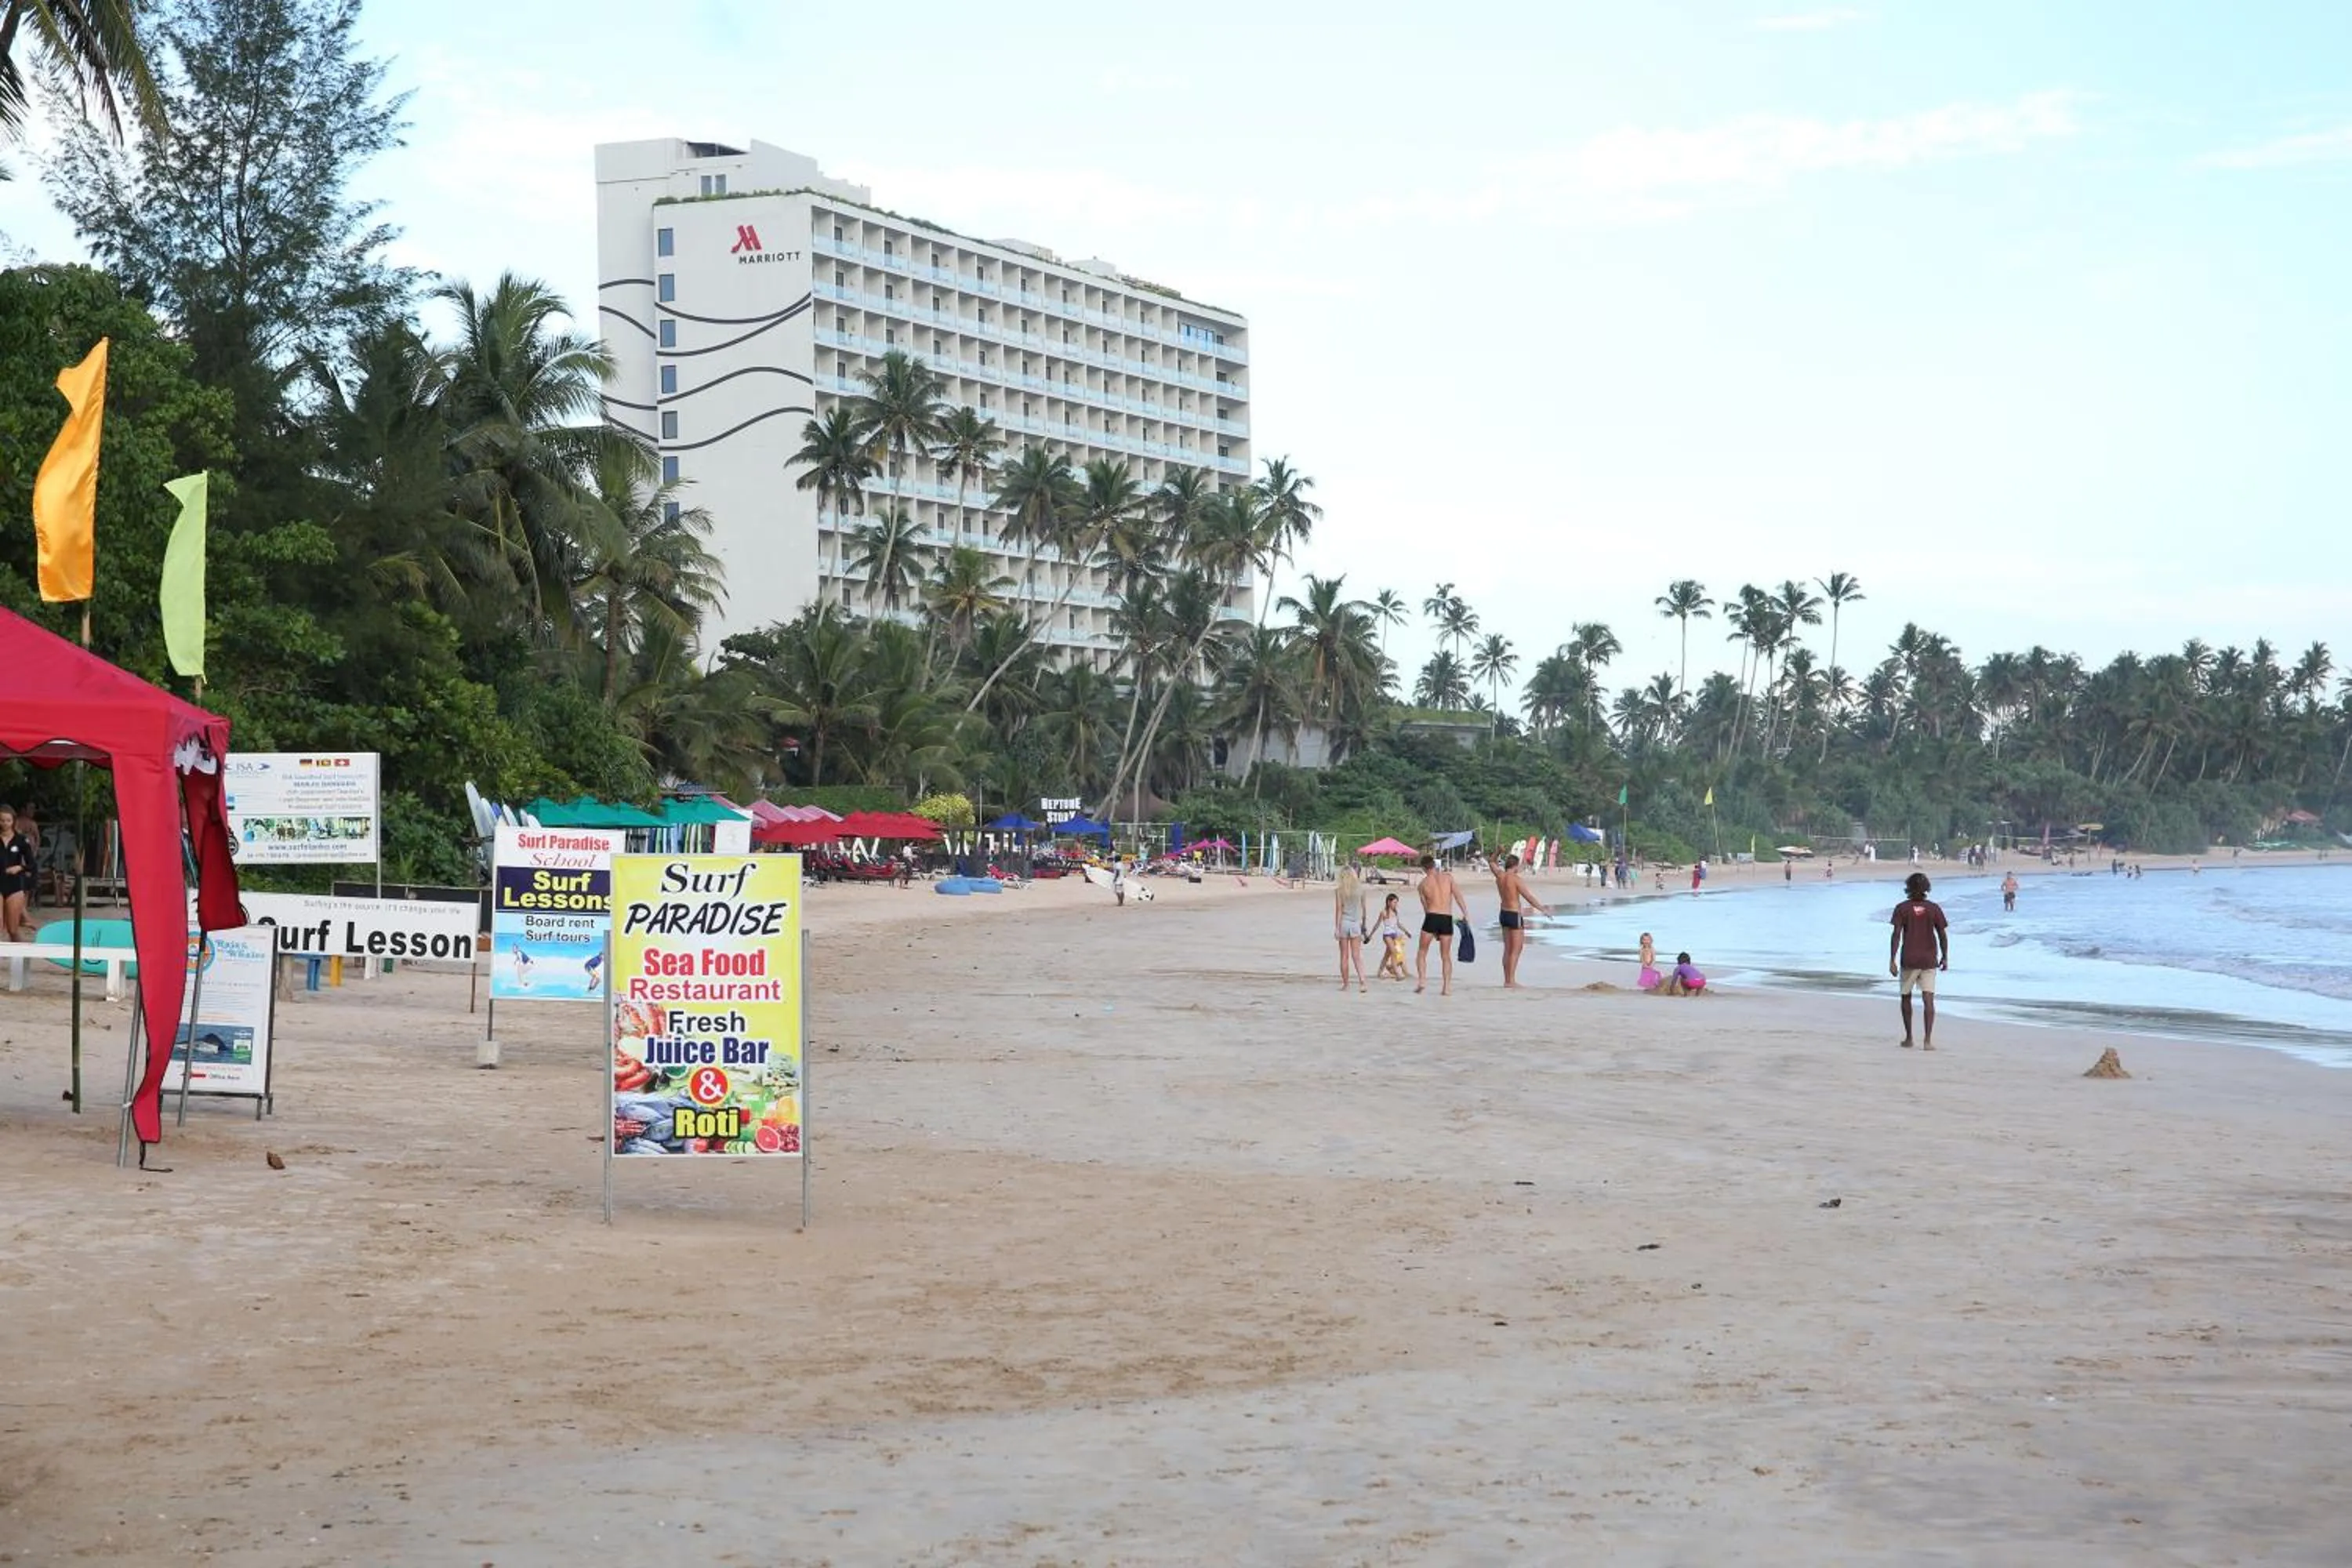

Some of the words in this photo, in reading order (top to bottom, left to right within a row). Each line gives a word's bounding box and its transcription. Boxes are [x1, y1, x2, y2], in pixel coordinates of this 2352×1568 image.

[739, 252, 800, 264] MARRIOTT
[518, 833, 546, 848] Surf
[550, 835, 610, 851] Paradise
[529, 851, 597, 867] School
[533, 869, 592, 891] Surf
[661, 862, 757, 897] Surf
[525, 915, 564, 927] Board
[568, 916, 594, 928] rent
[624, 902, 787, 936] PARADISE
[346, 921, 472, 959] Lesson
[526, 930, 553, 942] Surf
[556, 931, 590, 943] tours
[644, 949, 695, 976] Sea
[702, 949, 765, 976] Food
[630, 978, 781, 1001] Restaurant
[668, 1011, 746, 1033] Fresh
[644, 1037, 716, 1064] Juice
[723, 1038, 769, 1064] Bar
[698, 1071, 724, 1100] &
[673, 1107, 741, 1138] Roti
